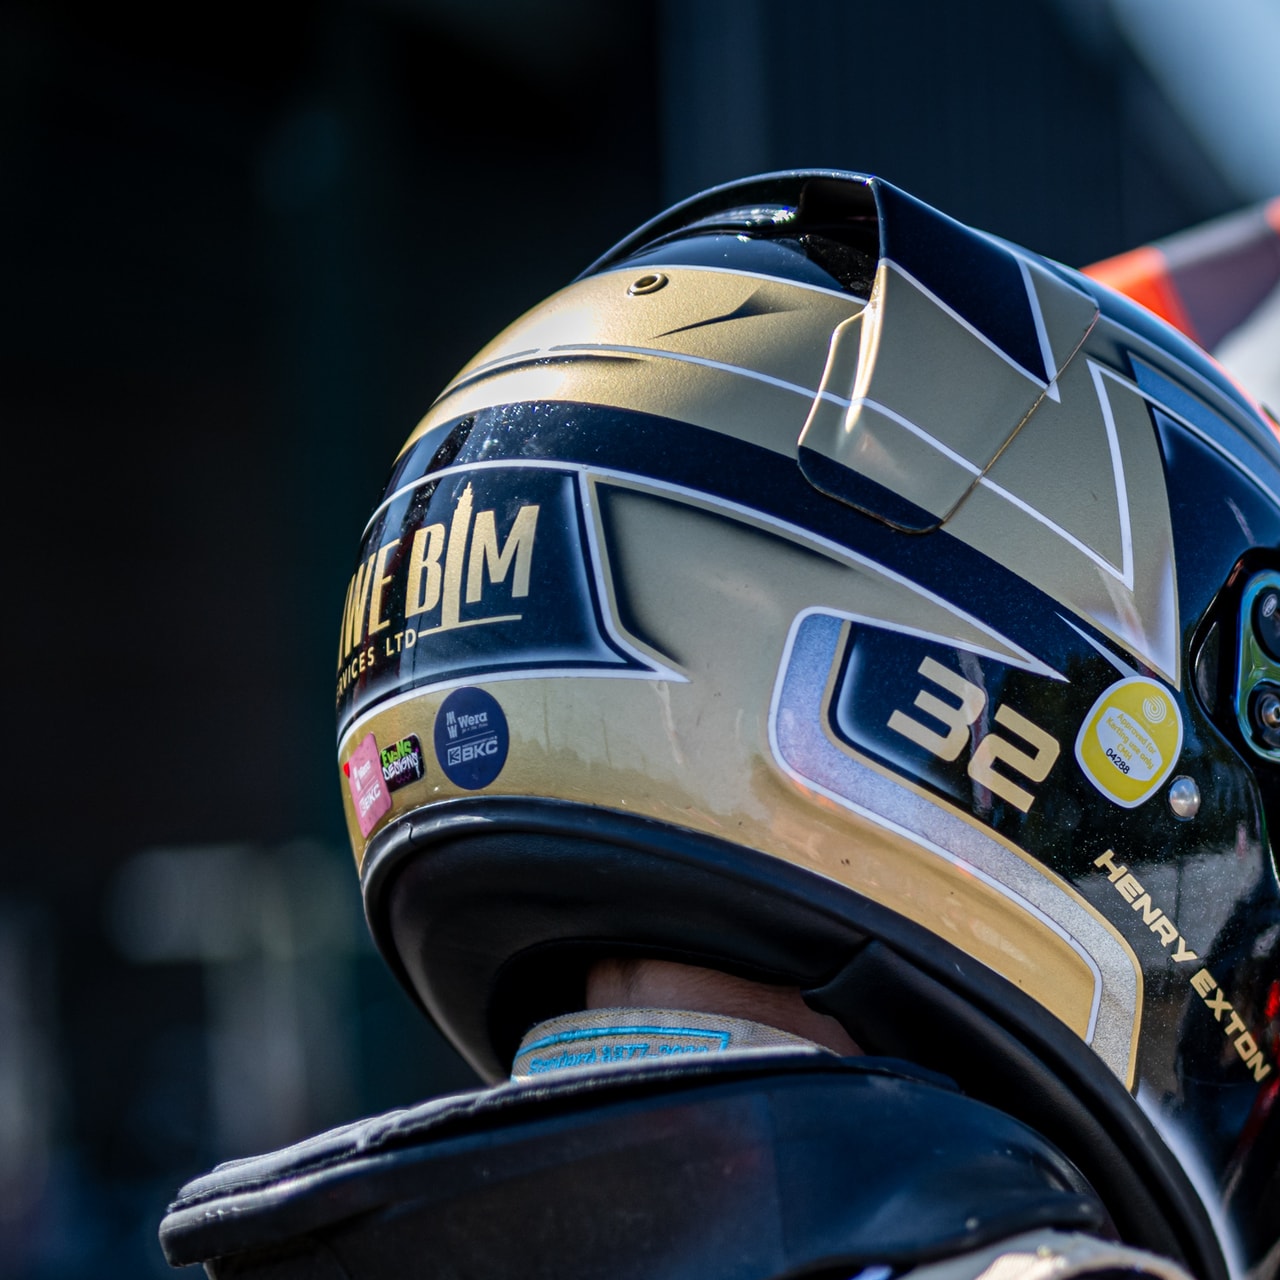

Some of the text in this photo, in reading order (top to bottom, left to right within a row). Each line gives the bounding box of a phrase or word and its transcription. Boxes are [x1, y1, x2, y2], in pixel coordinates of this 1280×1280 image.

[338, 538, 401, 668] WE
[386, 628, 417, 656] LTD
[457, 712, 488, 728] Wera
[886, 655, 1061, 813] 32
[1117, 713, 1148, 746] Approved
[1146, 742, 1156, 754] for
[1105, 747, 1130, 775] 04288
[1106, 716, 1154, 770] Karting use only
[1116, 743, 1133, 761] CMH
[1093, 849, 1271, 1083] HENRY EXTON
